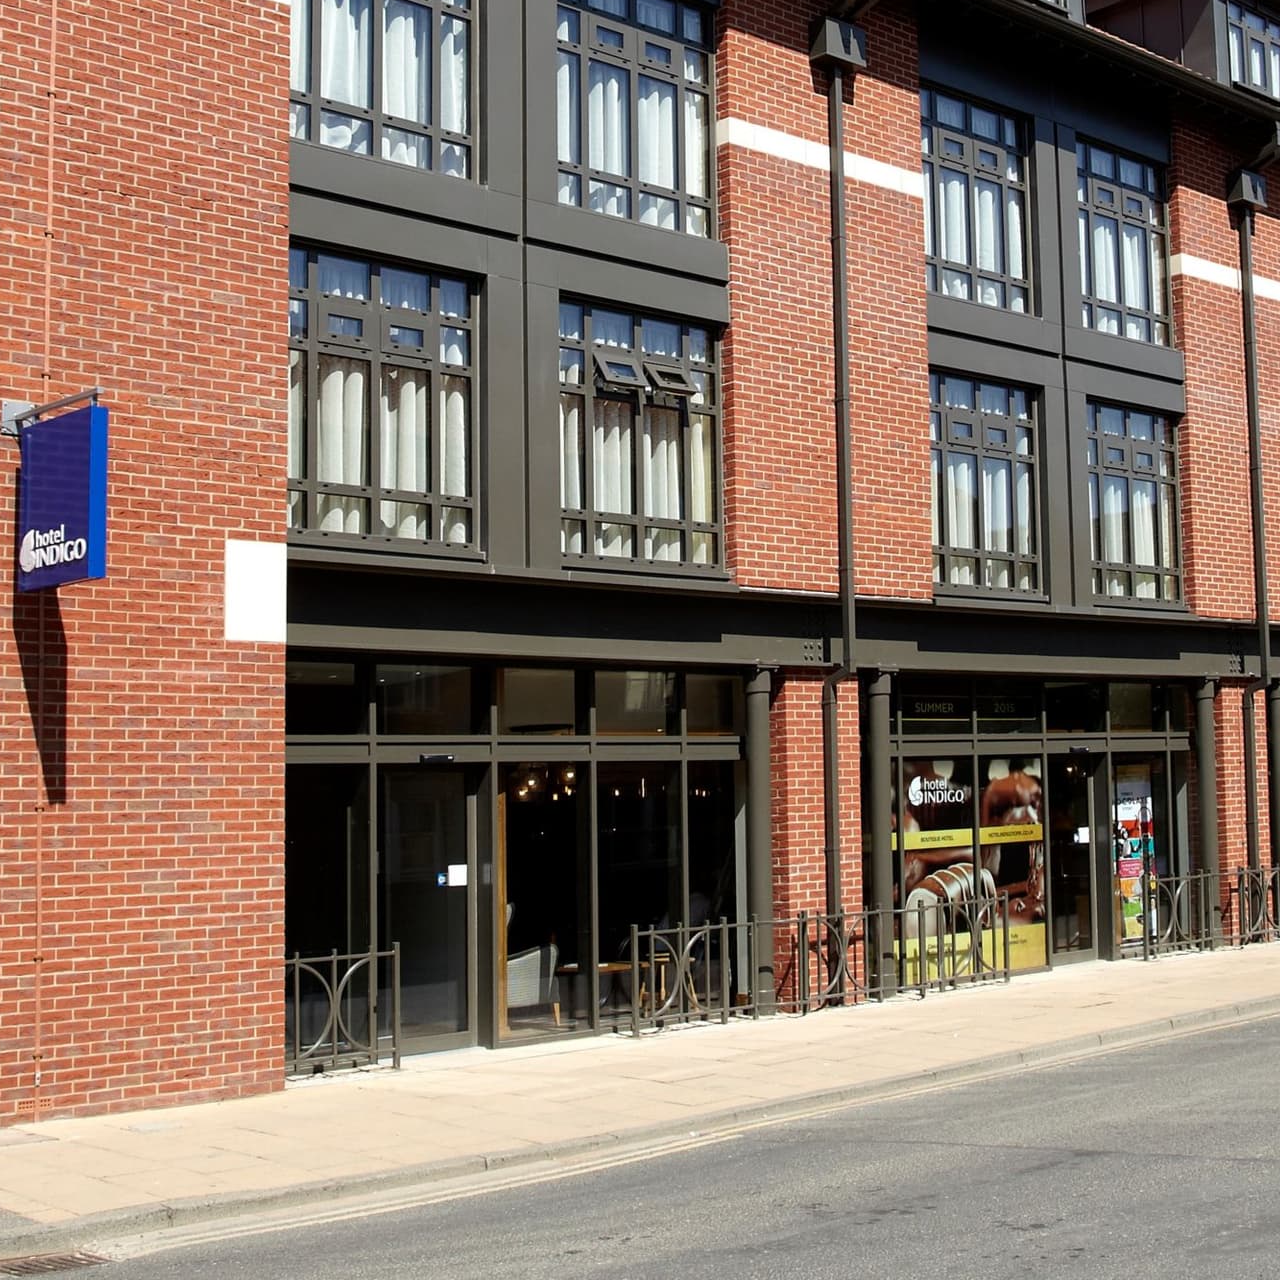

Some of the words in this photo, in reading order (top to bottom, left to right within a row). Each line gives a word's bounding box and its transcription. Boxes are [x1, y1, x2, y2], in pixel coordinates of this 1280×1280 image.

[35, 523, 65, 548] hotel
[35, 537, 87, 569] INDIGO
[914, 702, 954, 713] SUMMER
[994, 703, 1016, 713] 2015
[923, 777, 947, 790] hotel
[923, 790, 964, 804] INDIGO
